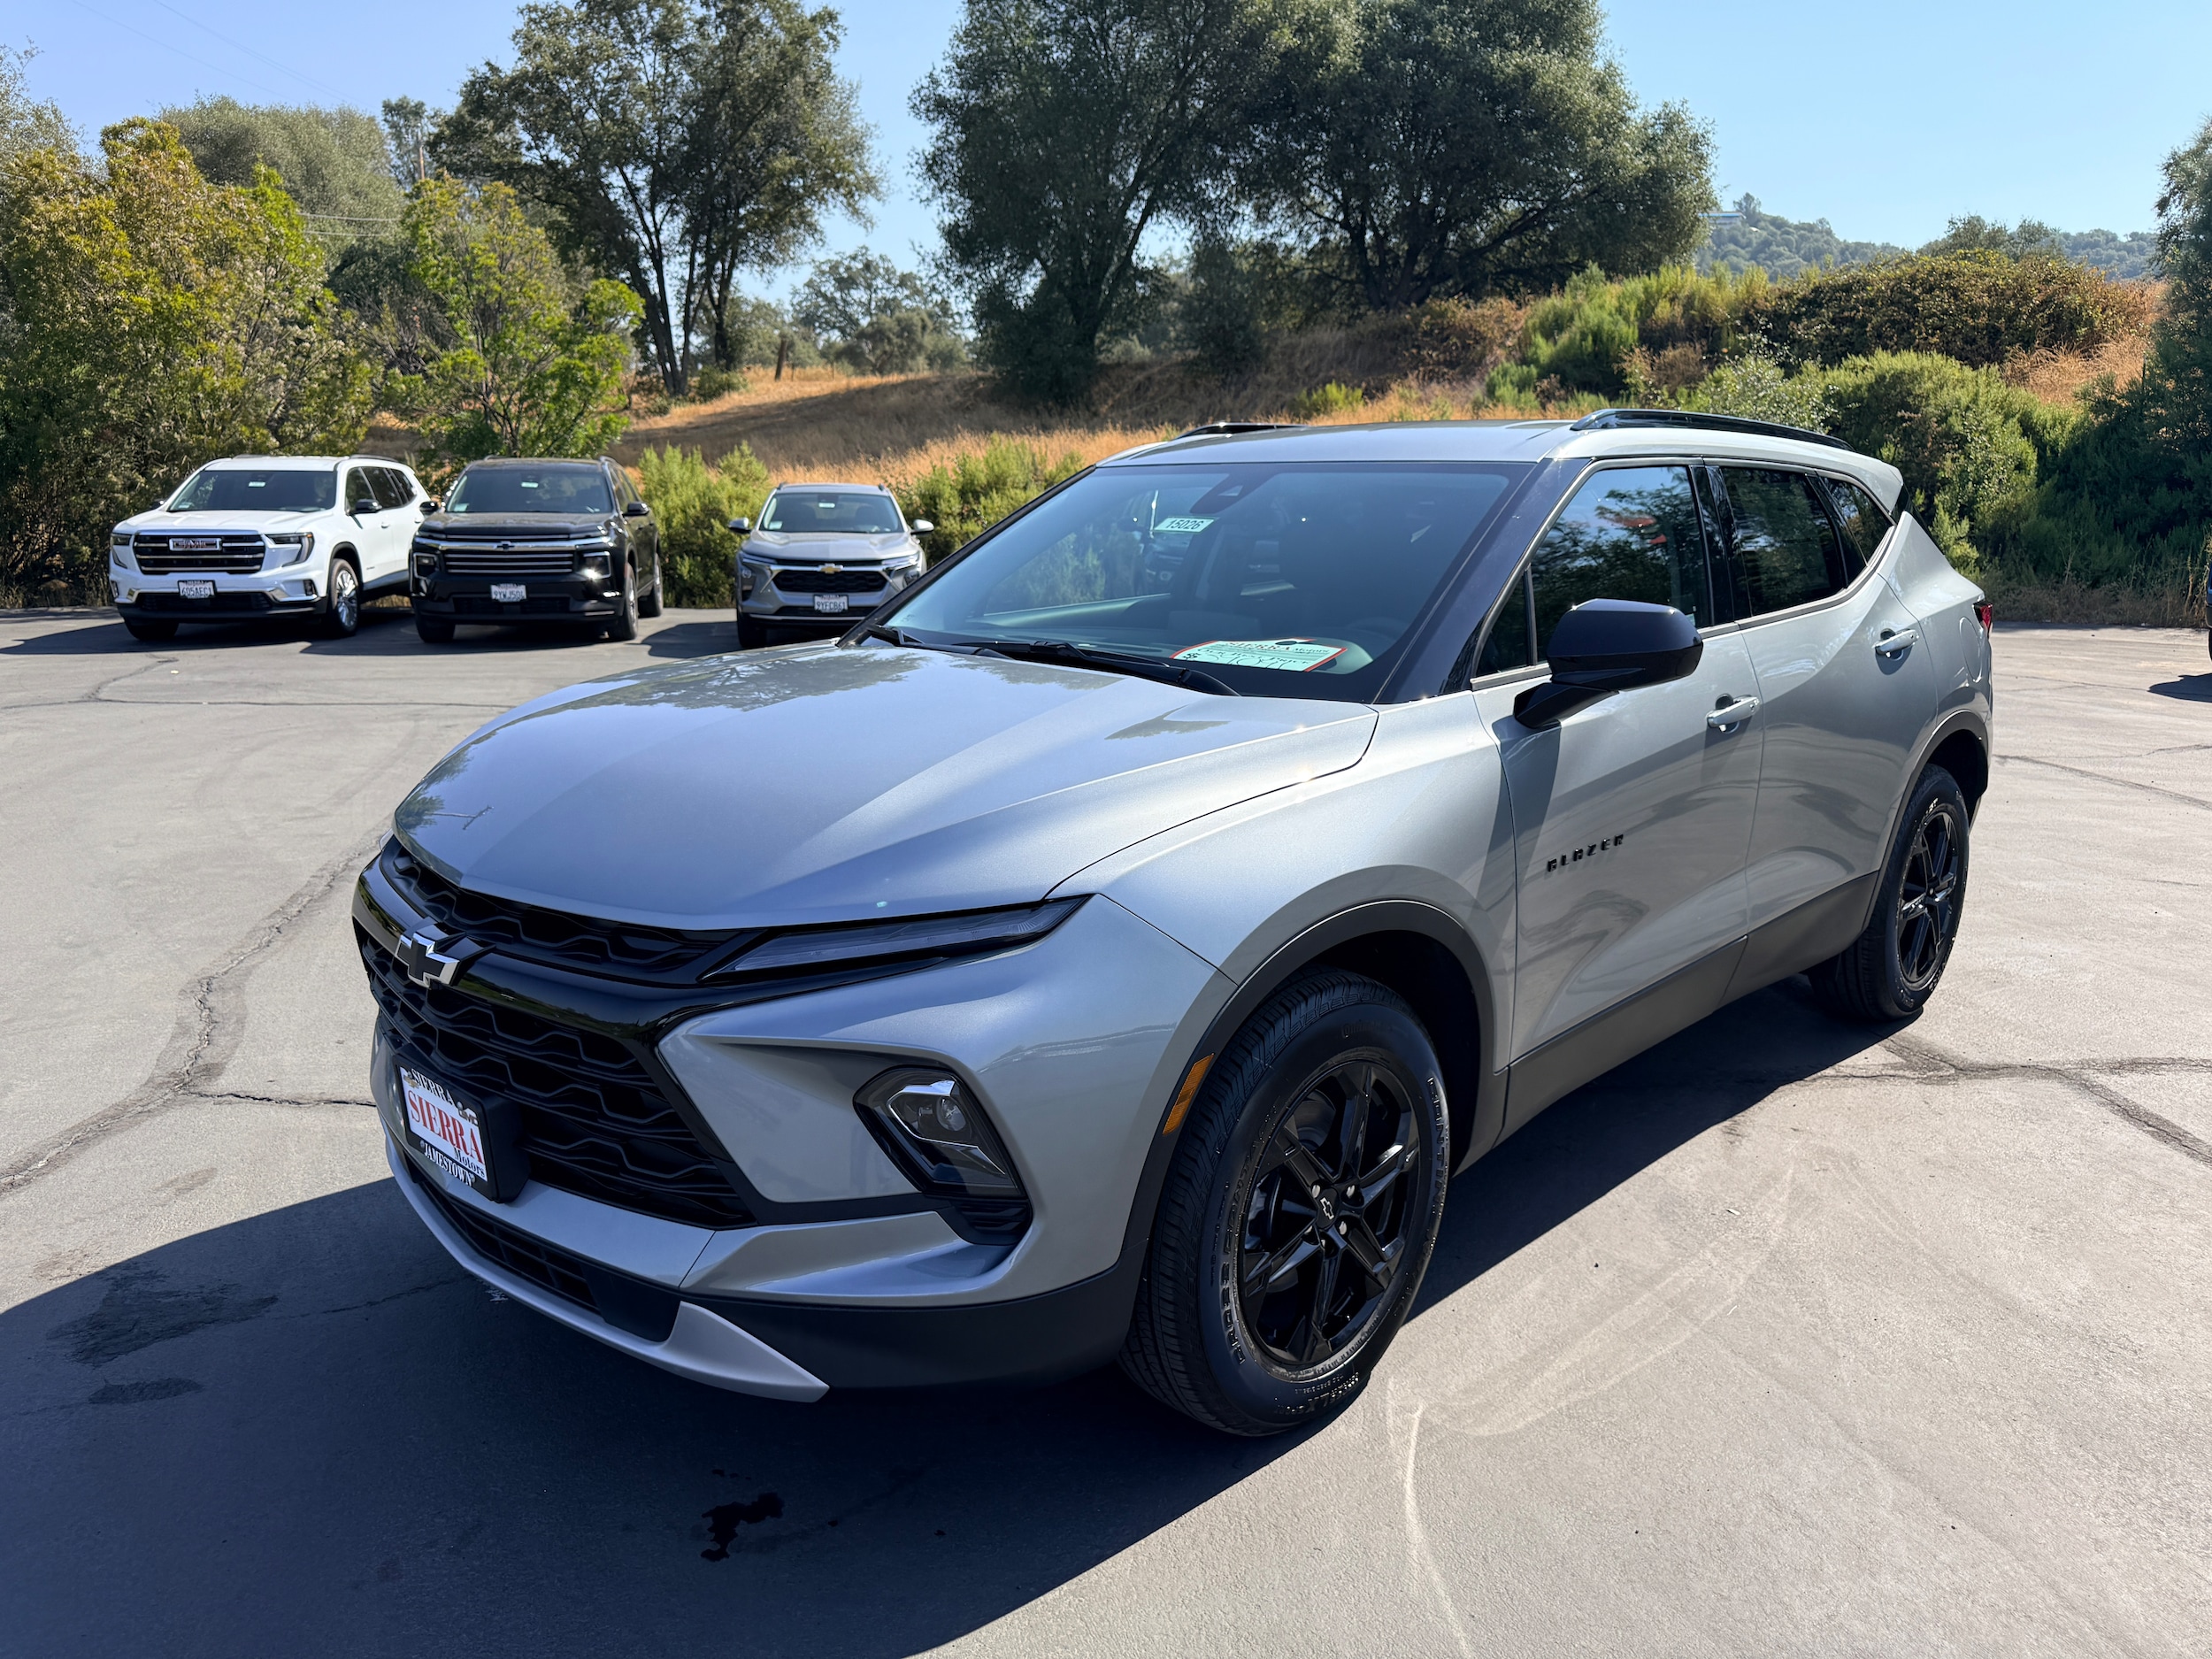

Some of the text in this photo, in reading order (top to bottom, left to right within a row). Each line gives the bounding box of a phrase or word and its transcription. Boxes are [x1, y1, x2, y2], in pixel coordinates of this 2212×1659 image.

[1166, 519, 1203, 529] 15026
[1546, 833, 1624, 872] BLAZER
[411, 1068, 456, 1106] SIERRA
[408, 1089, 485, 1164] SIERRA
[424, 1142, 473, 1187] JAMESTOWN
[454, 1147, 486, 1178] Motors
